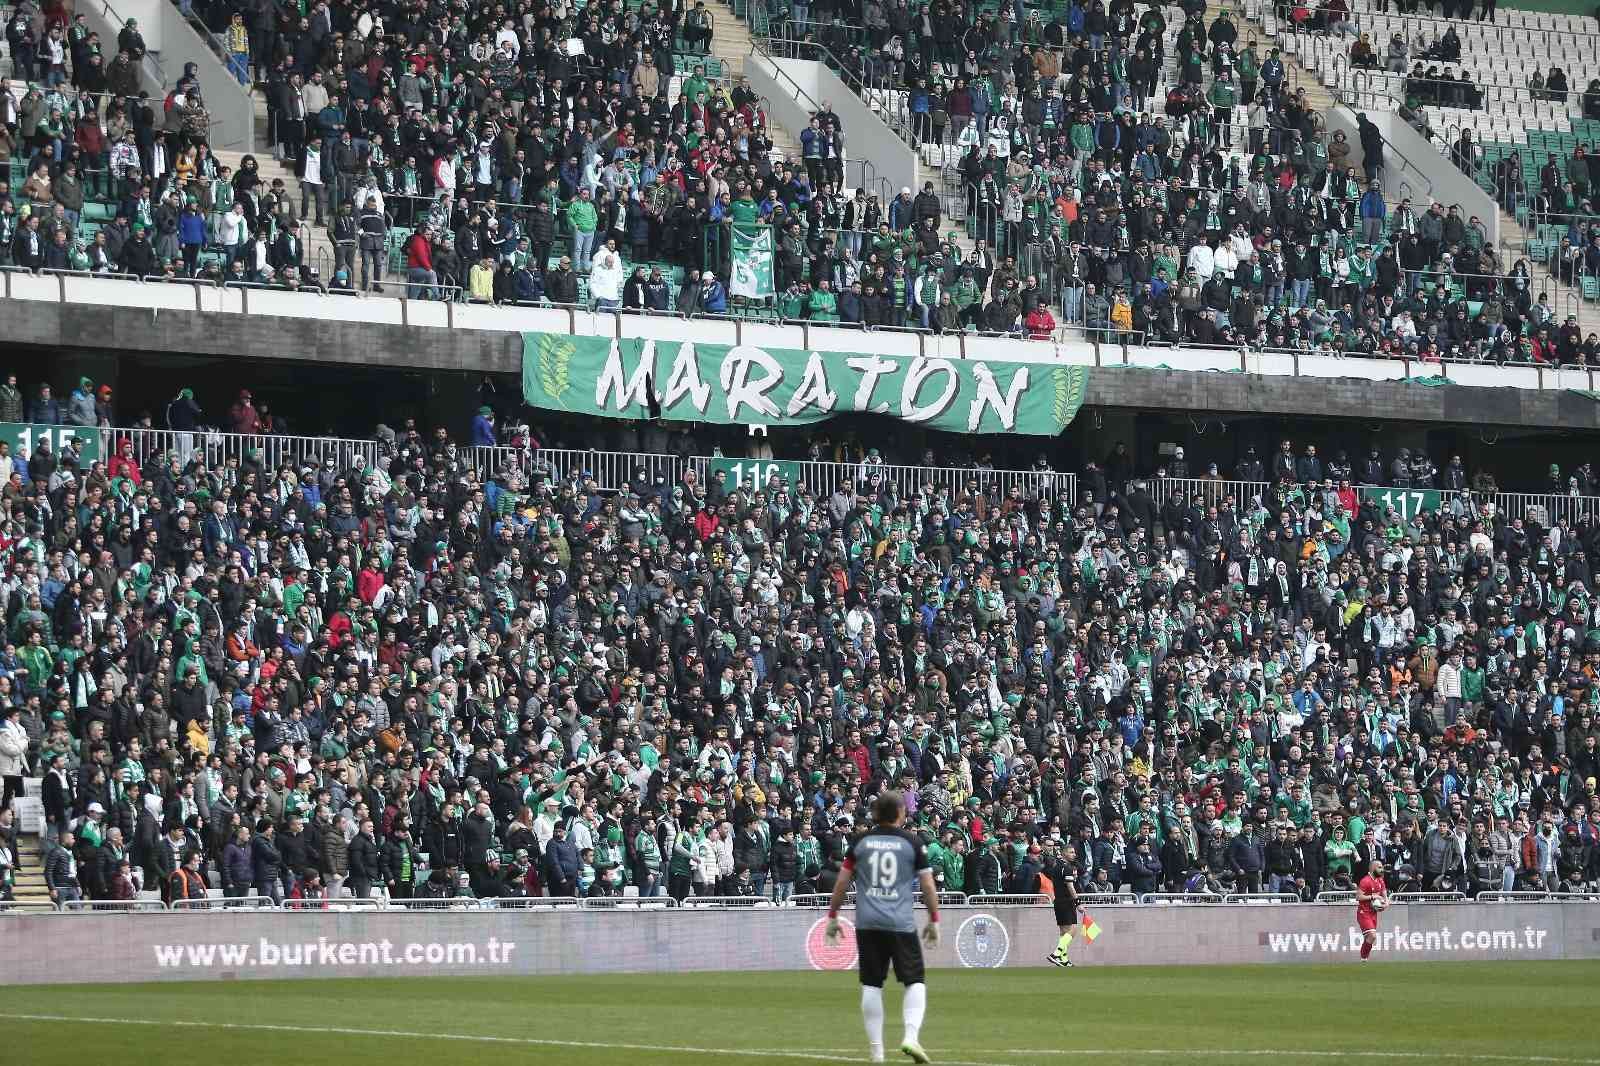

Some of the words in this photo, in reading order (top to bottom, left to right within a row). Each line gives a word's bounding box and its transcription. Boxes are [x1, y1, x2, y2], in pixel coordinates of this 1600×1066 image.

[594, 338, 1029, 433] MARATON
[1381, 491, 1425, 520] 117
[869, 851, 898, 887] 19
[154, 936, 515, 966] www.burkent.com.tr
